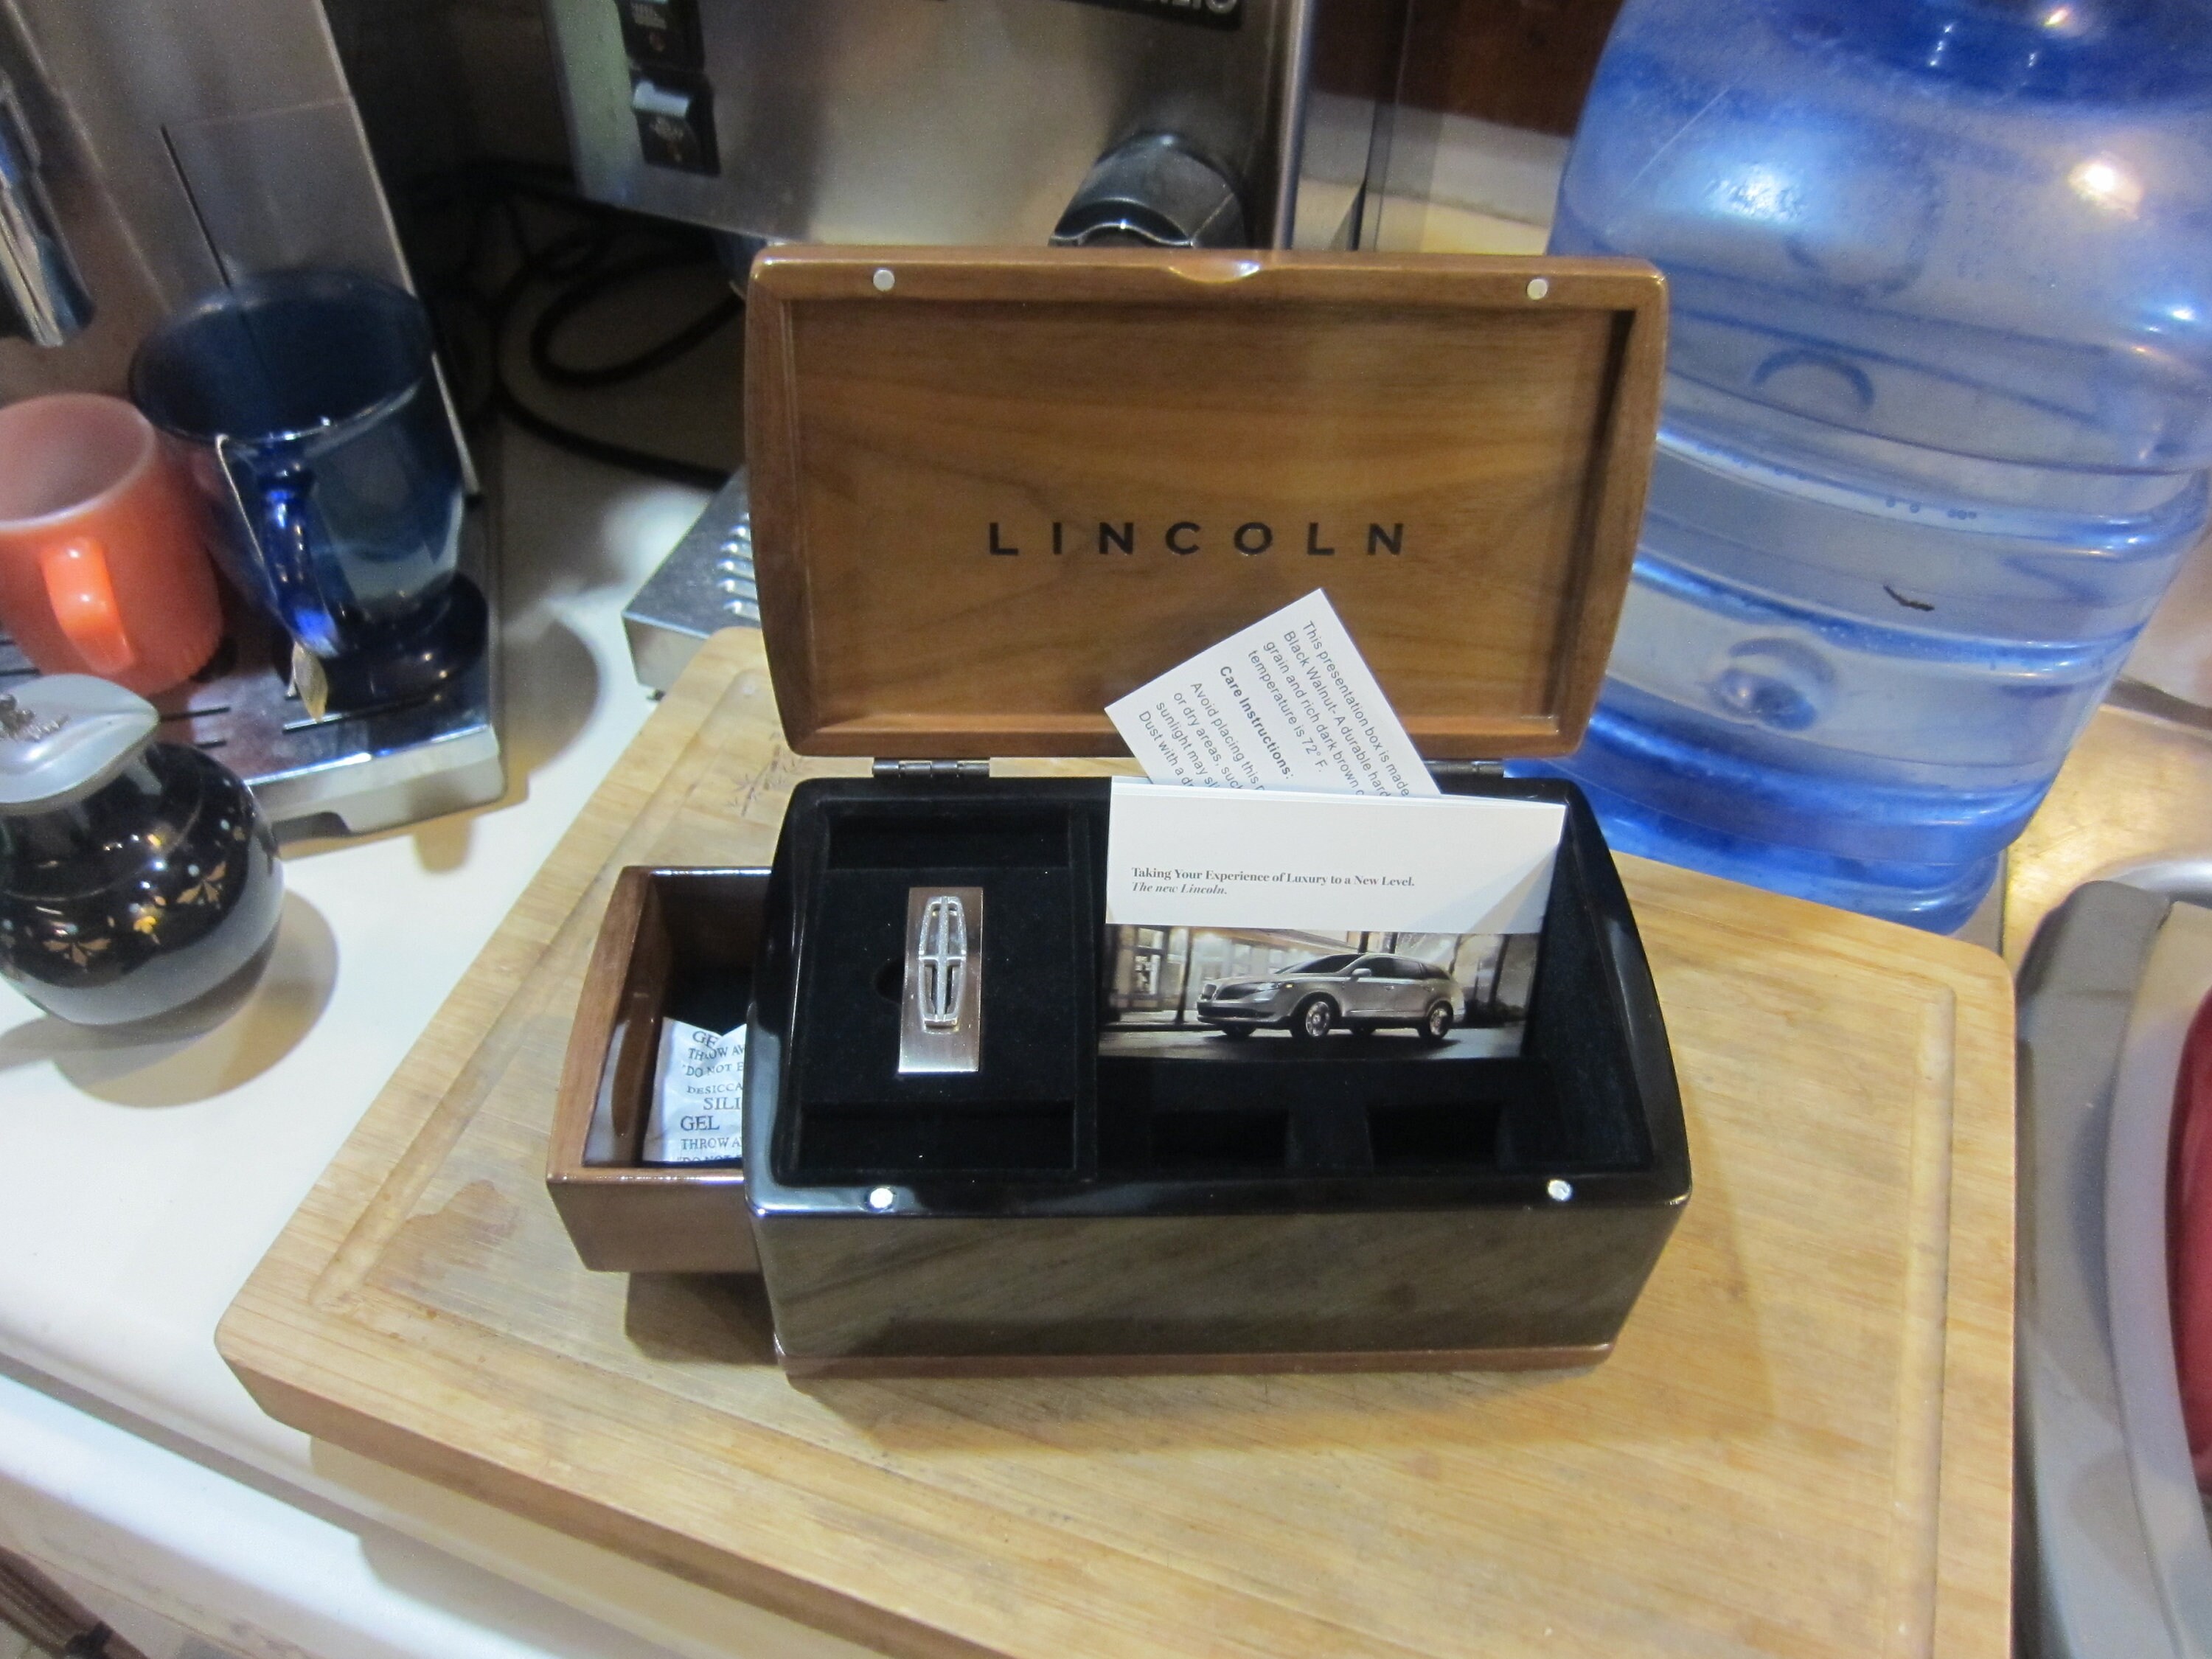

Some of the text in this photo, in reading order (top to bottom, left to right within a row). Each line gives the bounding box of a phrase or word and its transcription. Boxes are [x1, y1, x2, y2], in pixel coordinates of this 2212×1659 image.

[989, 522, 1404, 555] LINCOLN
[1173, 692, 1186, 705] or
[1183, 706, 1200, 727] dry
[1196, 727, 1222, 766] areas,
[1220, 666, 1294, 779] Care Instructions:
[1248, 650, 1298, 726] temperature
[1294, 725, 1305, 737] is
[1263, 641, 1290, 674] grain
[1286, 675, 1307, 699] and
[1303, 699, 1321, 723] rich
[1316, 723, 1338, 751] dark
[1332, 751, 1360, 789] brown
[1284, 631, 1310, 667] Black
[1307, 667, 1337, 714] Walnut-
[1334, 715, 1346, 726] A
[1340, 726, 1371, 771] durable
[1303, 621, 1410, 796] This presentation box is made
[1138, 711, 1164, 741] Dust
[1158, 740, 1180, 767] with
[1175, 768, 1184, 776] a
[1156, 702, 1192, 751] sunlight
[1187, 750, 1208, 776] may
[1190, 683, 1259, 785] Avoid placing this
[1131, 867, 1172, 880] Taking
[1175, 869, 1203, 880] Your
[1206, 871, 1270, 883] Experience
[1272, 872, 1285, 882] of
[1287, 873, 1327, 886] Luxury
[1330, 876, 1342, 884] to
[1354, 876, 1379, 886] New
[1382, 876, 1415, 886] Level.
[1131, 882, 1153, 892] The
[1180, 883, 1228, 895] Lincoln.
[706, 1063, 732, 1076] NOT
[681, 1116, 720, 1130] GEL
[681, 1138, 729, 1150] THROW
